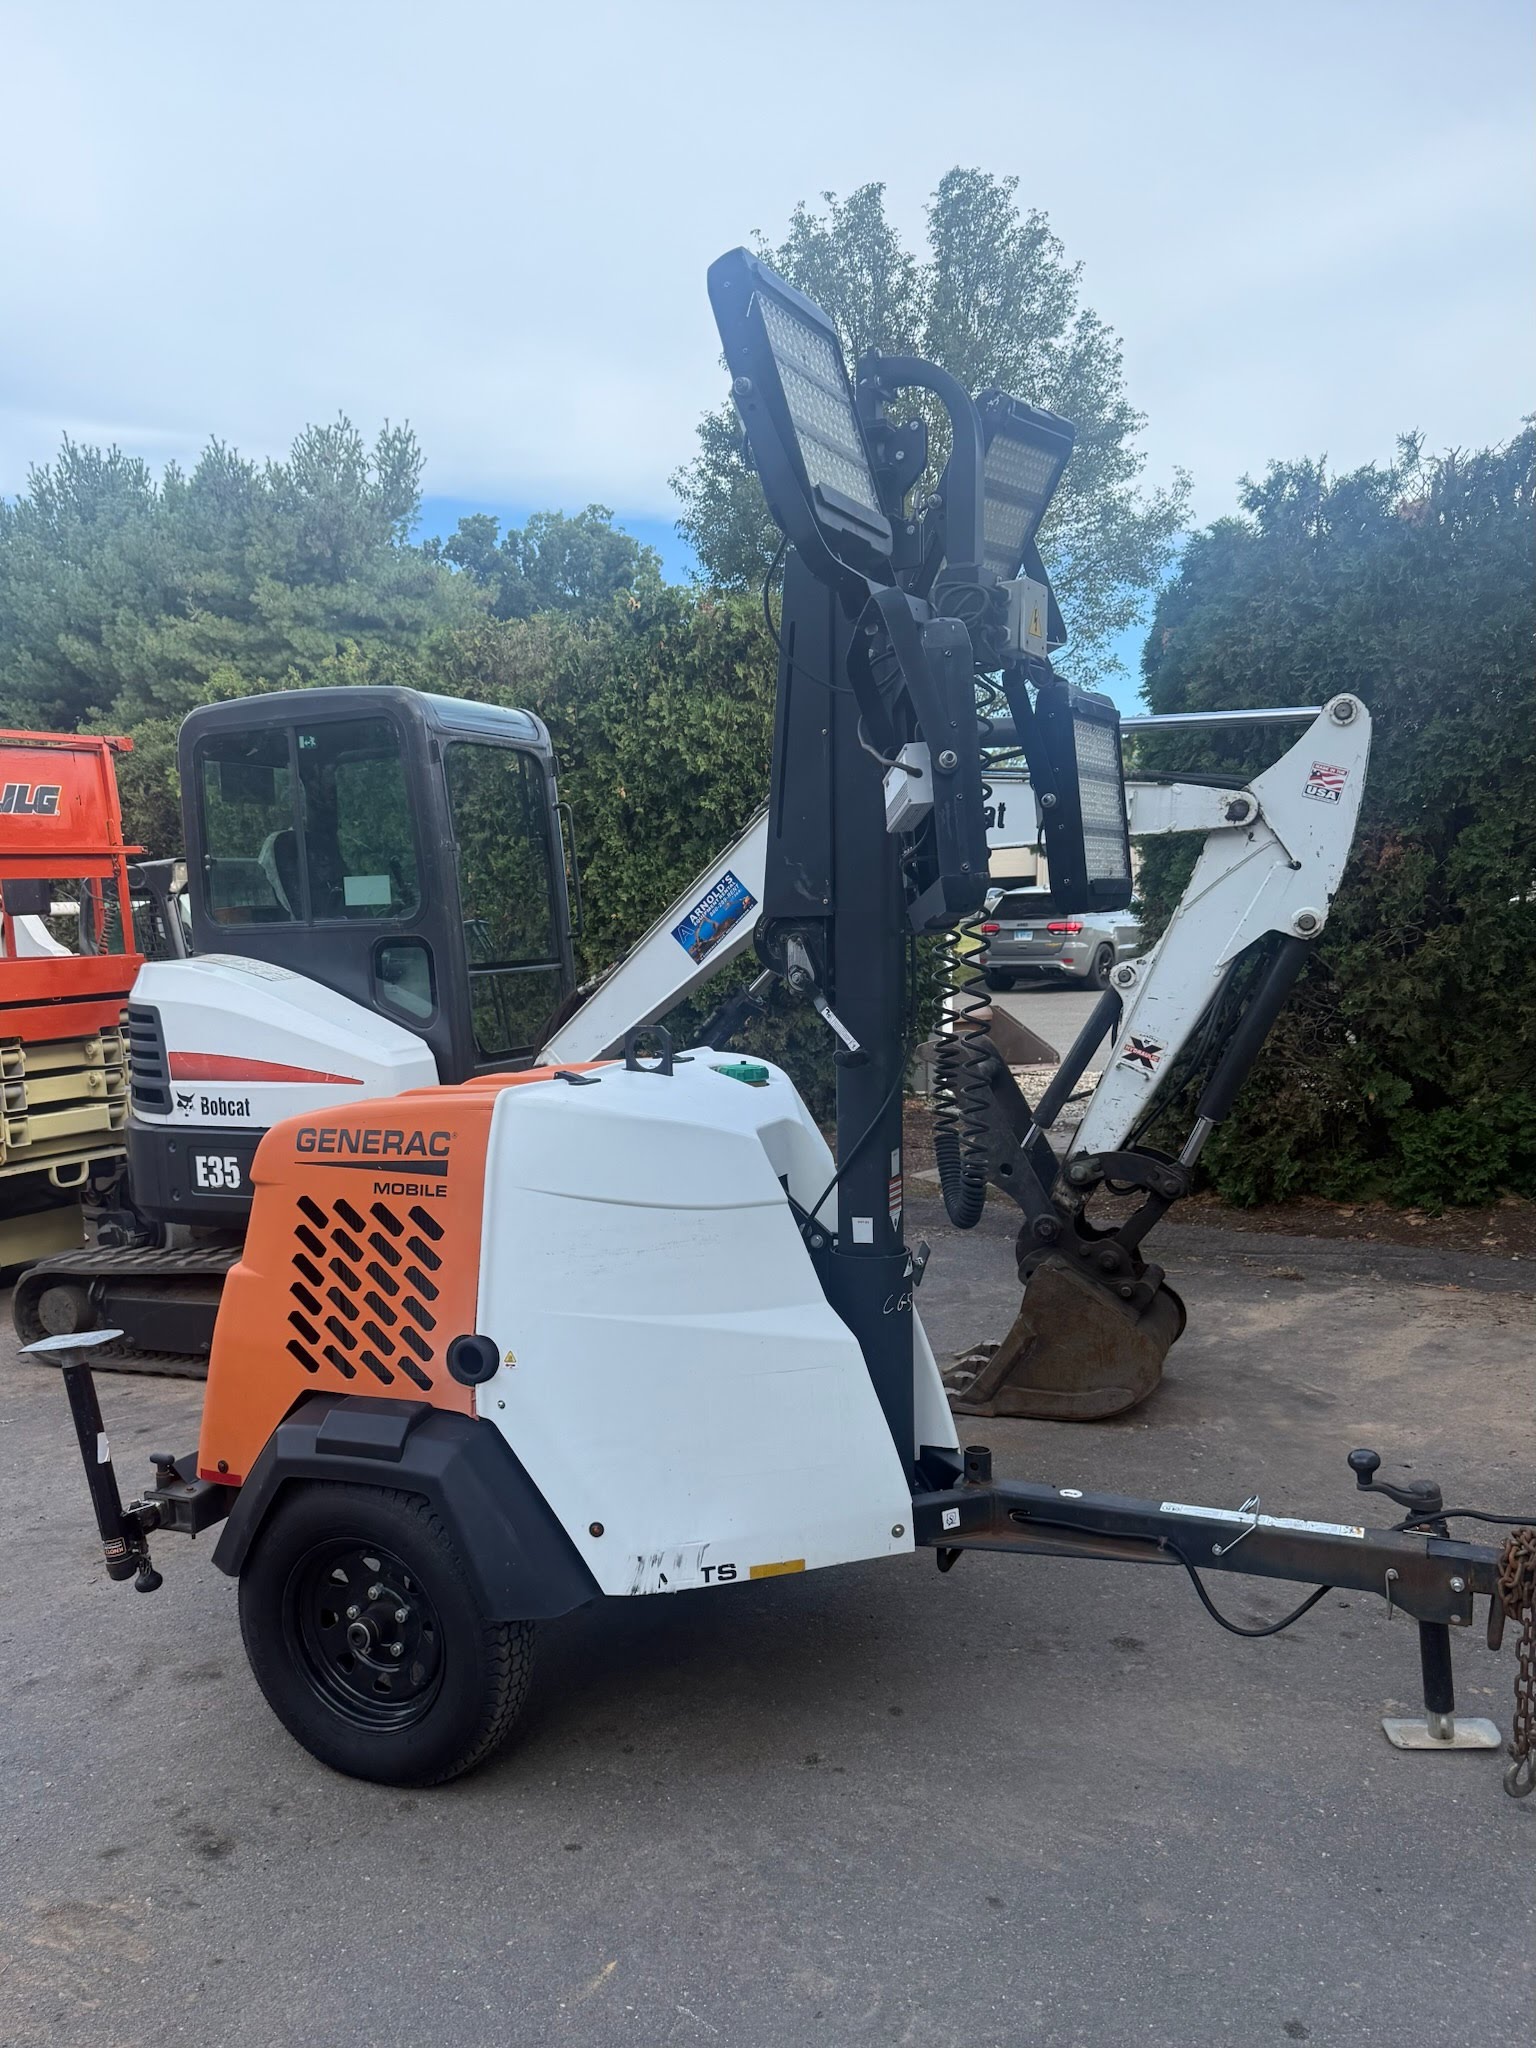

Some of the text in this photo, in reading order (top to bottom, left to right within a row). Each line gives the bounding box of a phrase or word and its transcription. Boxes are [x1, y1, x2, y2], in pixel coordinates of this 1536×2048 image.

[0, 783, 62, 816] JLG
[1305, 785, 1337, 800] USA
[689, 874, 733, 925] ARNOLD'S
[200, 1096, 250, 1117] Bobcat
[296, 1127, 451, 1157] GENERAC
[195, 1155, 241, 1189] E35
[373, 1182, 448, 1198] MOBILE
